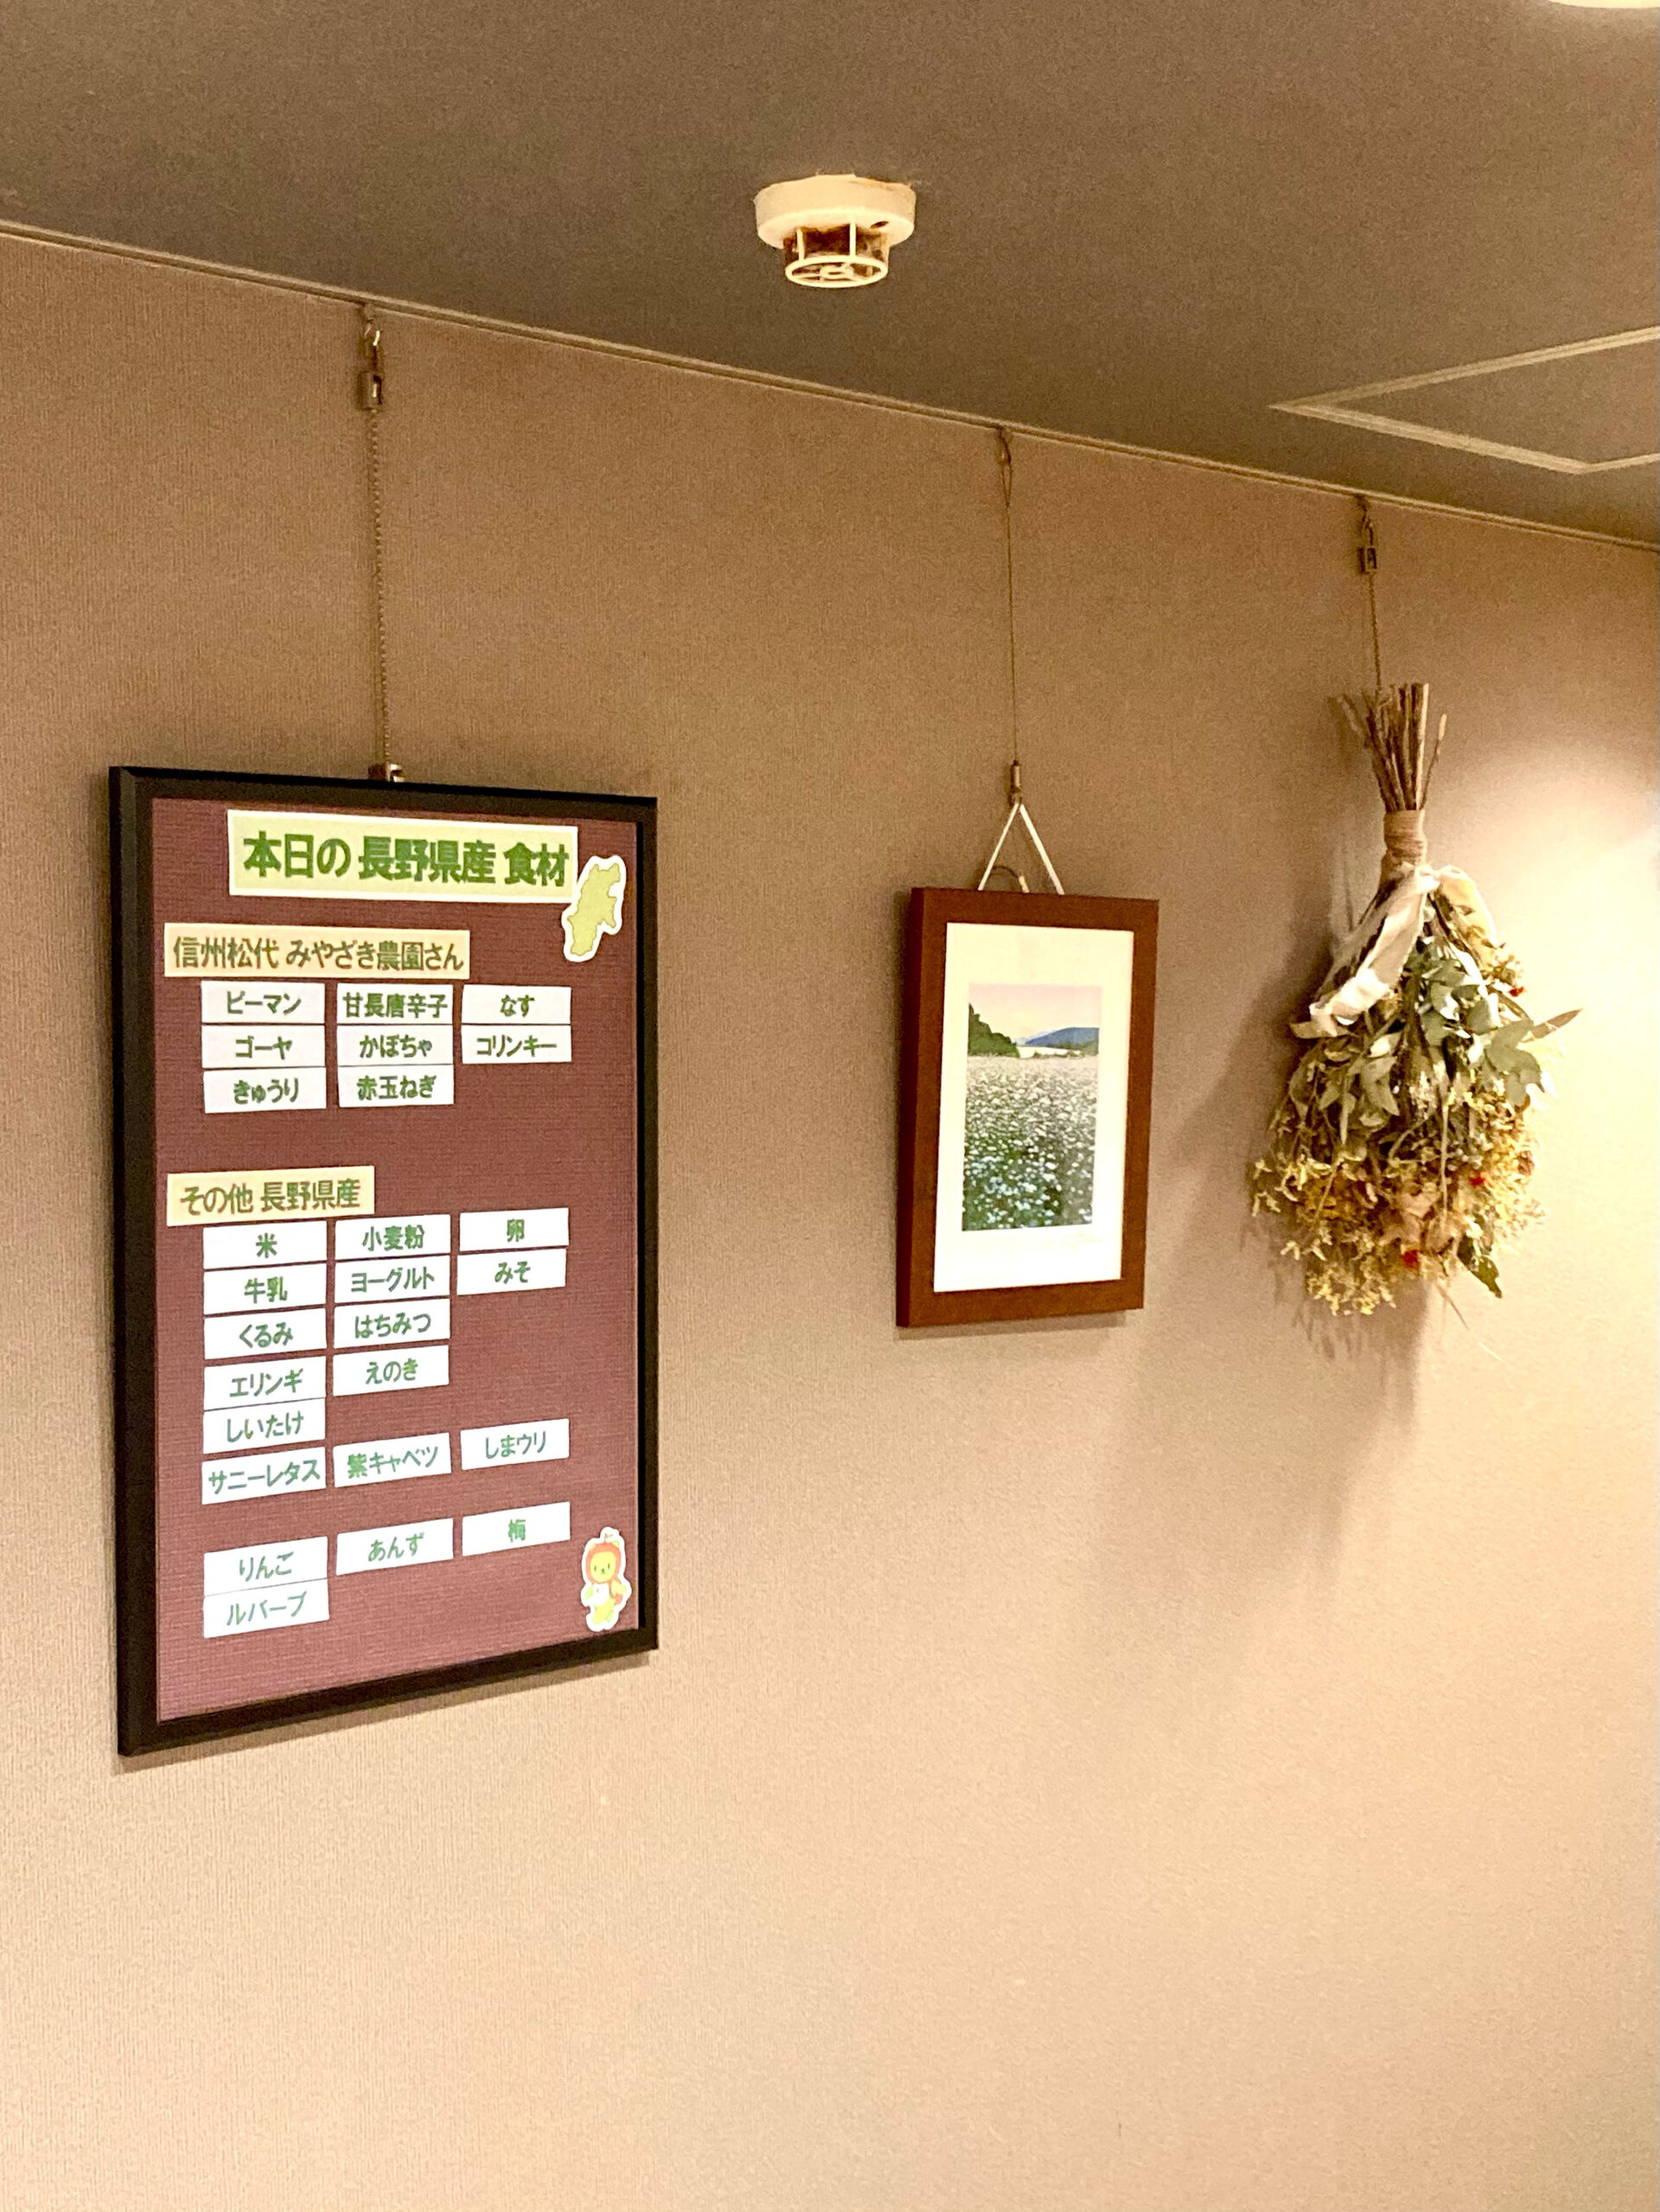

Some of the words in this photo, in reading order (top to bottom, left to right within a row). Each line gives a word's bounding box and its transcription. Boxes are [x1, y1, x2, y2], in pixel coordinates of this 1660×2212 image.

[242, 830, 352, 879] 本日の
[357, 834, 497, 885] 長野県産
[502, 841, 570, 887] 食材
[172, 936, 280, 969] 信州松代
[285, 939, 464, 972] みやざき農園さん
[227, 990, 302, 1016] ピーマン
[342, 991, 449, 1020] 甘長唐辛子
[499, 994, 535, 1019] なす
[235, 1034, 293, 1061] ゴーヤ
[359, 1033, 433, 1059] かぼちゃ
[476, 1034, 558, 1058] コリンキー
[233, 1077, 299, 1105] きゅうり
[356, 1074, 437, 1102] 赤玉ねぎ
[180, 1182, 254, 1216] その他
[259, 1177, 361, 1213] 長野県産
[361, 1224, 425, 1252] 小麦粉
[506, 1218, 526, 1243] 卵
[255, 1232, 278, 1259] 米
[350, 1265, 435, 1293] ヨーグルト
[494, 1260, 532, 1285] みそ
[243, 1275, 289, 1305] 牛乳
[239, 1321, 294, 1349] くるみ
[354, 1312, 431, 1339] はちみつ
[229, 1367, 304, 1398] エリンギ
[364, 1357, 419, 1386] えのき
[227, 1410, 304, 1442] しいたけ
[485, 1430, 546, 1460] しまウリ
[347, 1445, 438, 1480] 紫キャベツ
[208, 1459, 322, 1495] サニーレタス
[507, 1518, 527, 1544] 梅
[367, 1531, 425, 1563] あんず
[239, 1550, 295, 1582] りんご
